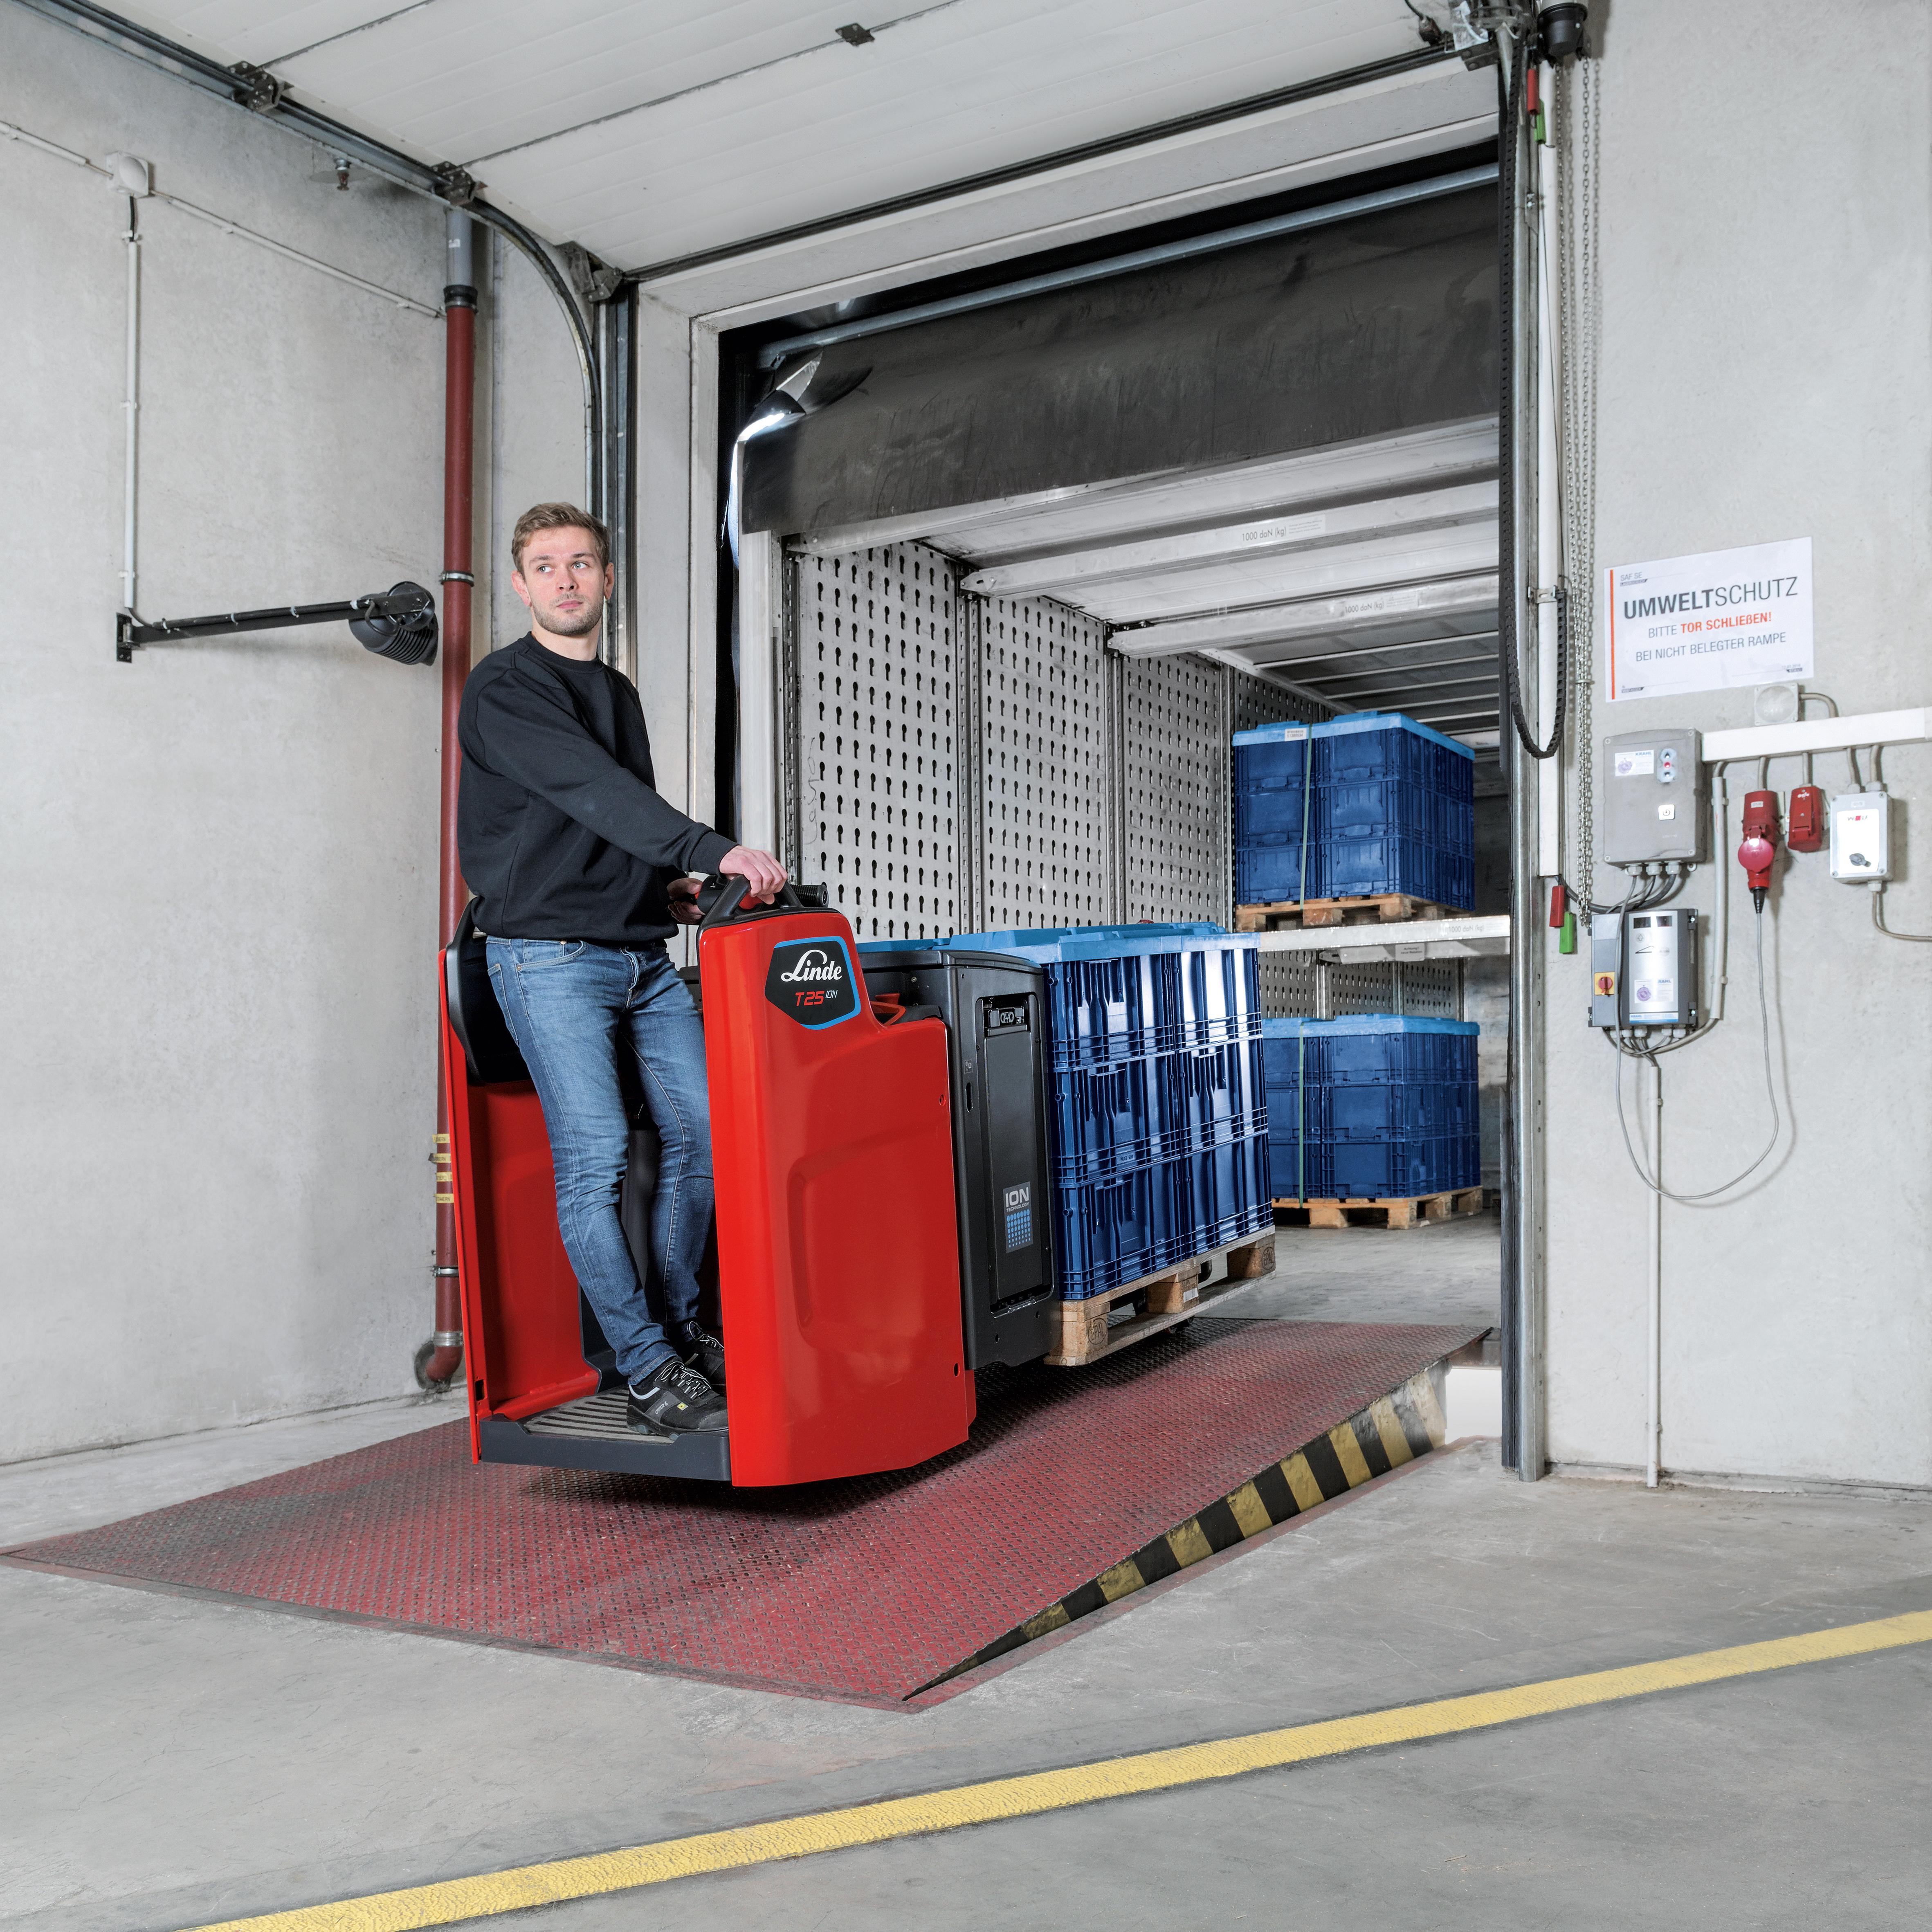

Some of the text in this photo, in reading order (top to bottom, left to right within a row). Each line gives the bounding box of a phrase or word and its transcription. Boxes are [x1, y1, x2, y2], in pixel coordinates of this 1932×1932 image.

[1242, 531, 1257, 541] 1000
[1260, 529, 1272, 538] daN
[1275, 526, 1286, 537] (kg)
[1624, 576, 1798, 619] UMWELTSCHUTZ
[1345, 605, 1359, 613] 1000
[1648, 625, 1677, 638] BITTE
[1680, 621, 1703, 634] TOR
[1636, 632, 1786, 662] BEI NICHT BELEGTER RAMPE
[781, 949, 842, 982] Linde
[825, 990, 838, 998] ION
[1005, 1187, 1029, 1207] ION
[1006, 1202, 1029, 1212] TECHNOLOGY
[655, 1403, 665, 1414] OTTER
